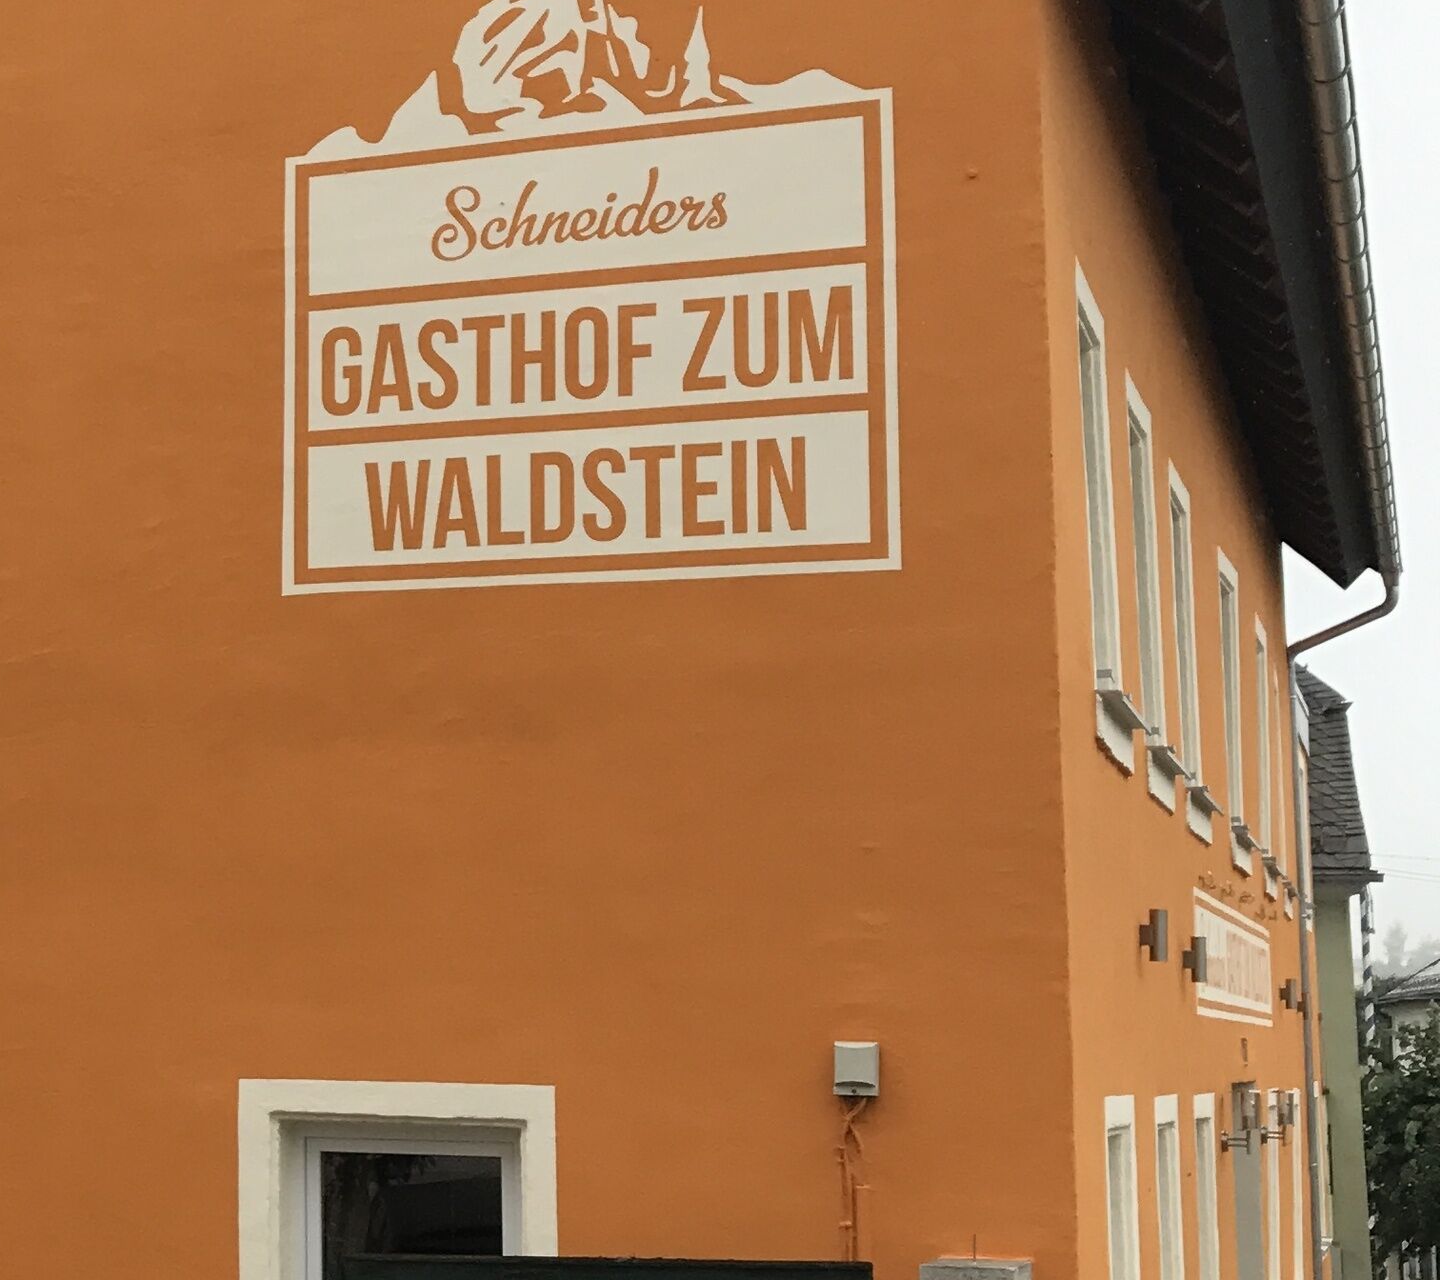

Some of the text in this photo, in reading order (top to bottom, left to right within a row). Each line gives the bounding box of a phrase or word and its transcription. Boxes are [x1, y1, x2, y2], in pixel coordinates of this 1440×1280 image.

[431, 166, 728, 262] Schneiders
[320, 284, 854, 416] GASTHOF ZUM
[364, 435, 807, 552] WALDSTEIN
